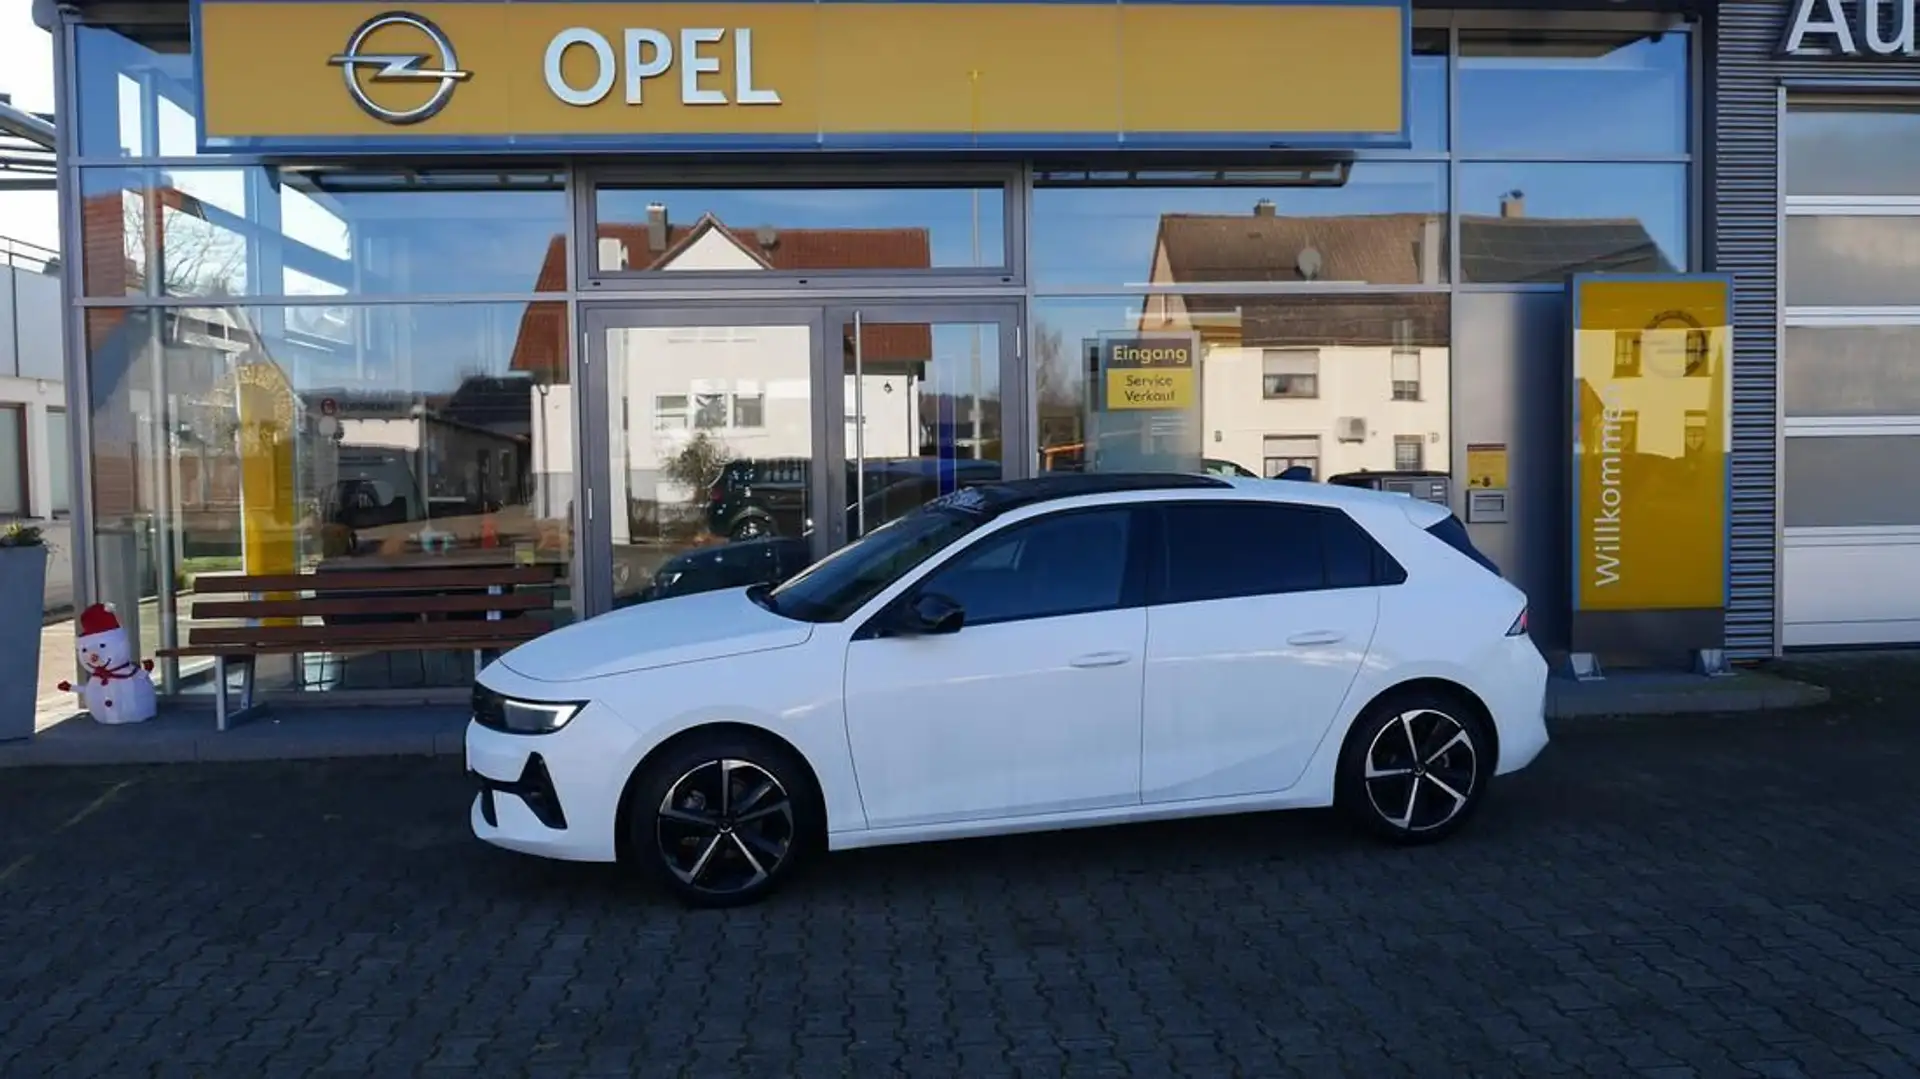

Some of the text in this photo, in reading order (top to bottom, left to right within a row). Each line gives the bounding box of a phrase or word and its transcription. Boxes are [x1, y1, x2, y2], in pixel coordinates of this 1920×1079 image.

[544, 26, 783, 107] OPEL
[1113, 345, 1187, 364] Eingang
[1126, 374, 1173, 387] Service
[1124, 390, 1175, 403] Verkauf
[1593, 384, 1622, 587] Willkommen
